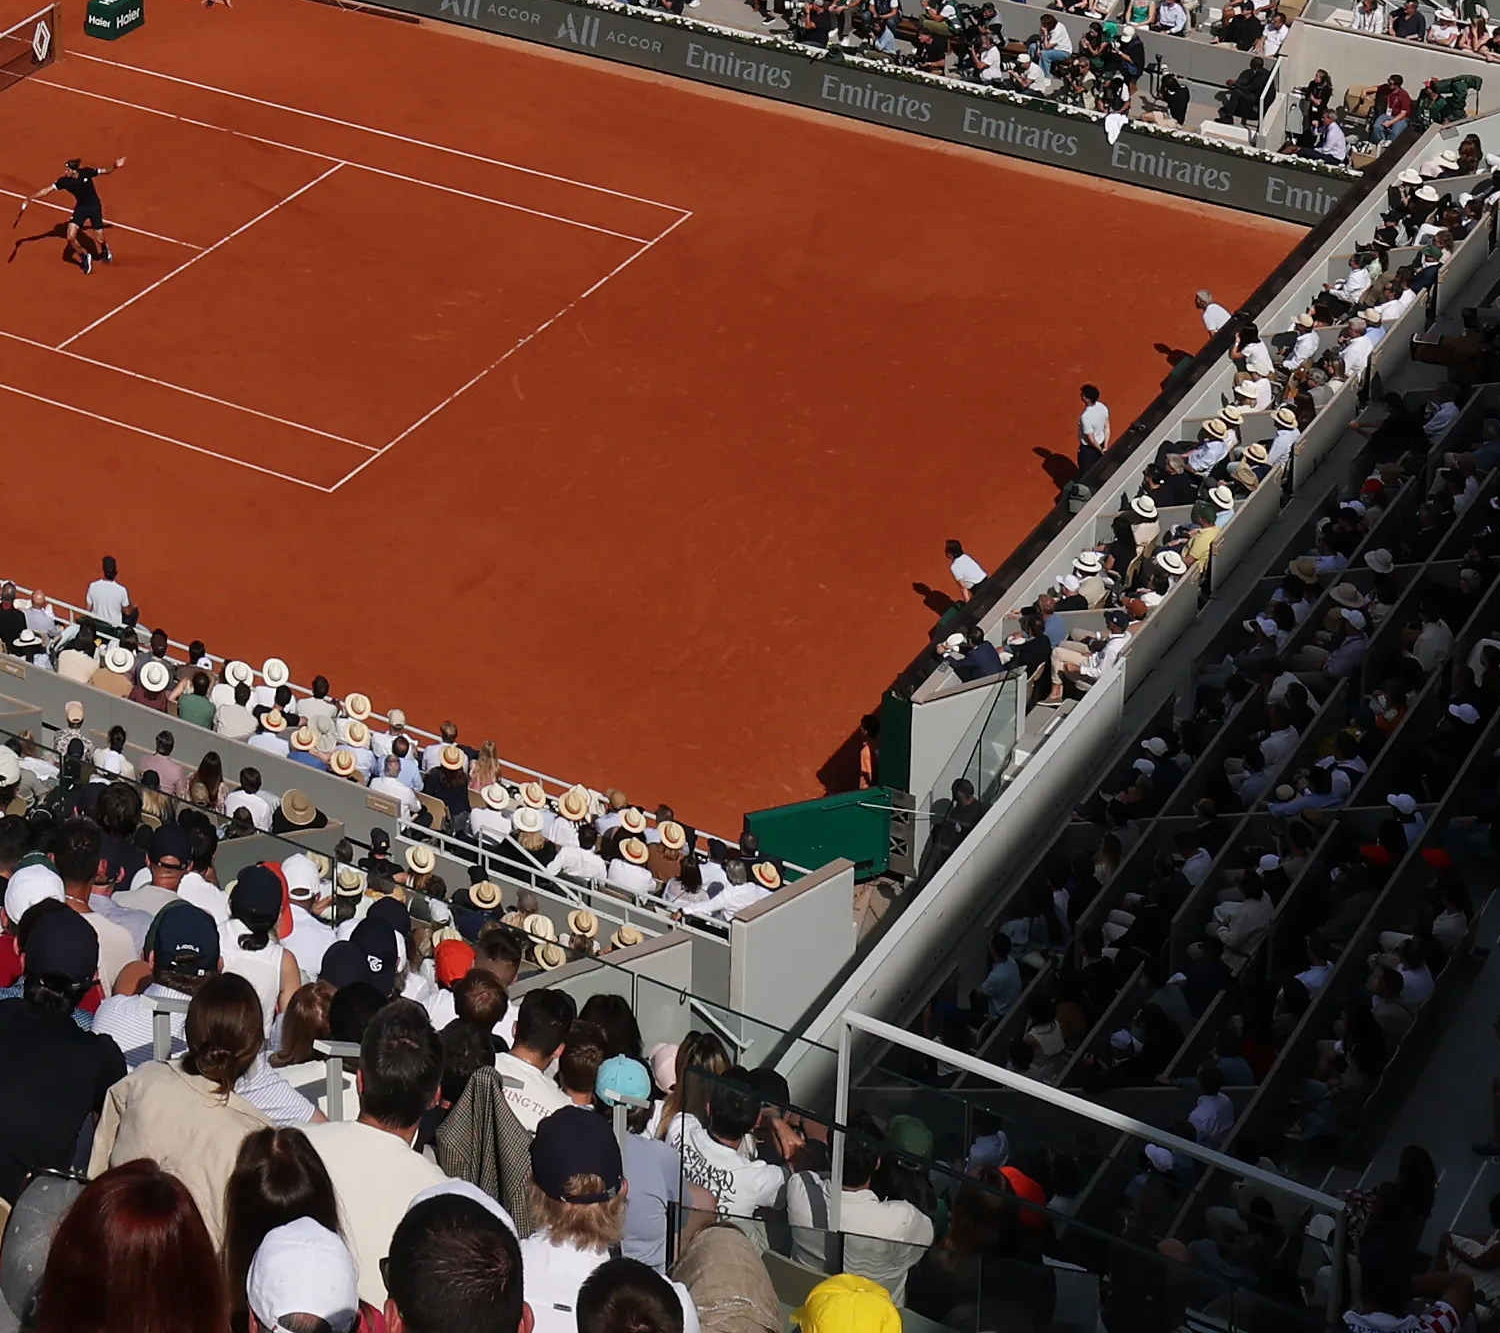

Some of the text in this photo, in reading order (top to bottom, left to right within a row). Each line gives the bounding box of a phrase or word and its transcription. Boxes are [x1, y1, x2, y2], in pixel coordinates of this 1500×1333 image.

[88, 7, 141, 29] Haier Haier
[487, 2, 541, 26] ACCOR
[606, 30, 663, 54] ACCOR
[685, 41, 792, 90] Emirates
[820, 73, 932, 123] Emirates
[962, 106, 1079, 157] Emirates
[1110, 141, 1231, 192] Emirates
